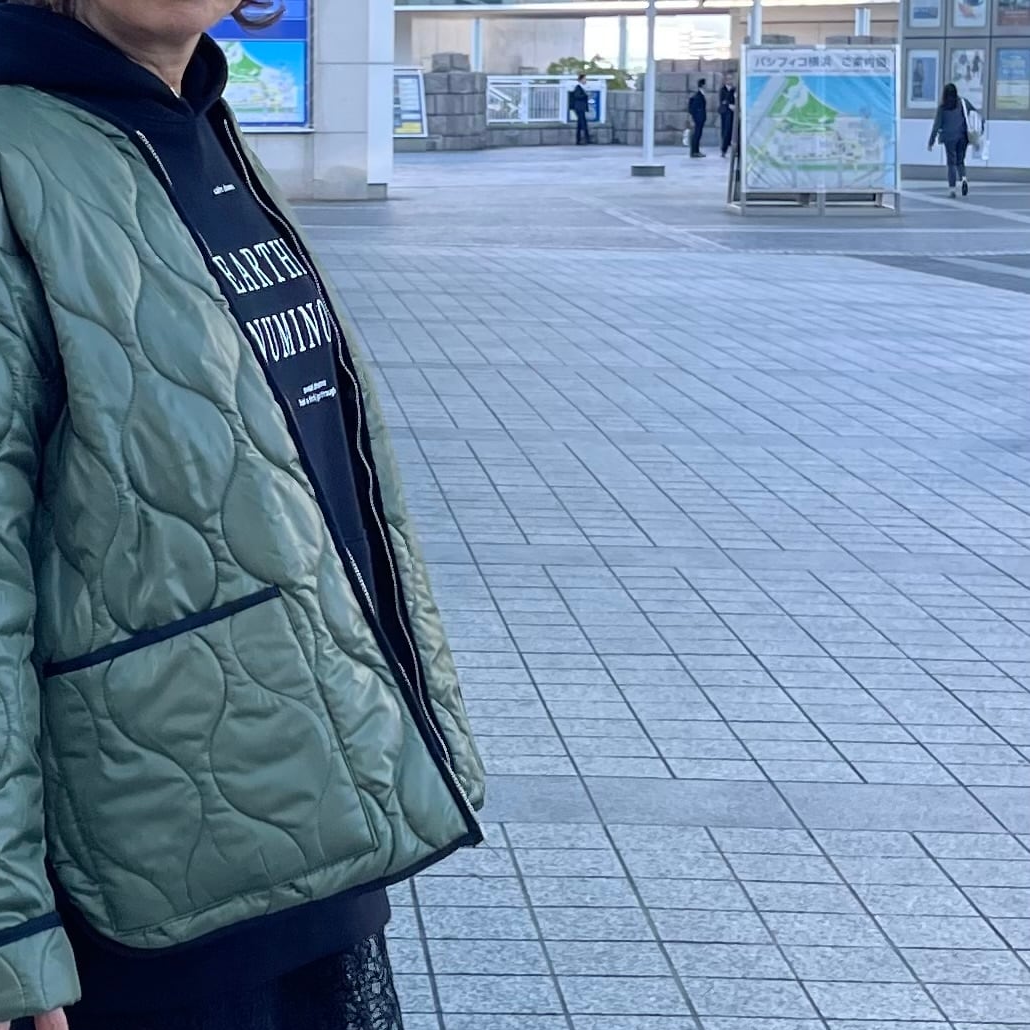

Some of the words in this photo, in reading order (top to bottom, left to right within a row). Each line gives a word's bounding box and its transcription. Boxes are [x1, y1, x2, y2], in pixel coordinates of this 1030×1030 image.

[754, 55, 832, 68] パシフィコ横浜
[211, 237, 308, 295] EARTH
